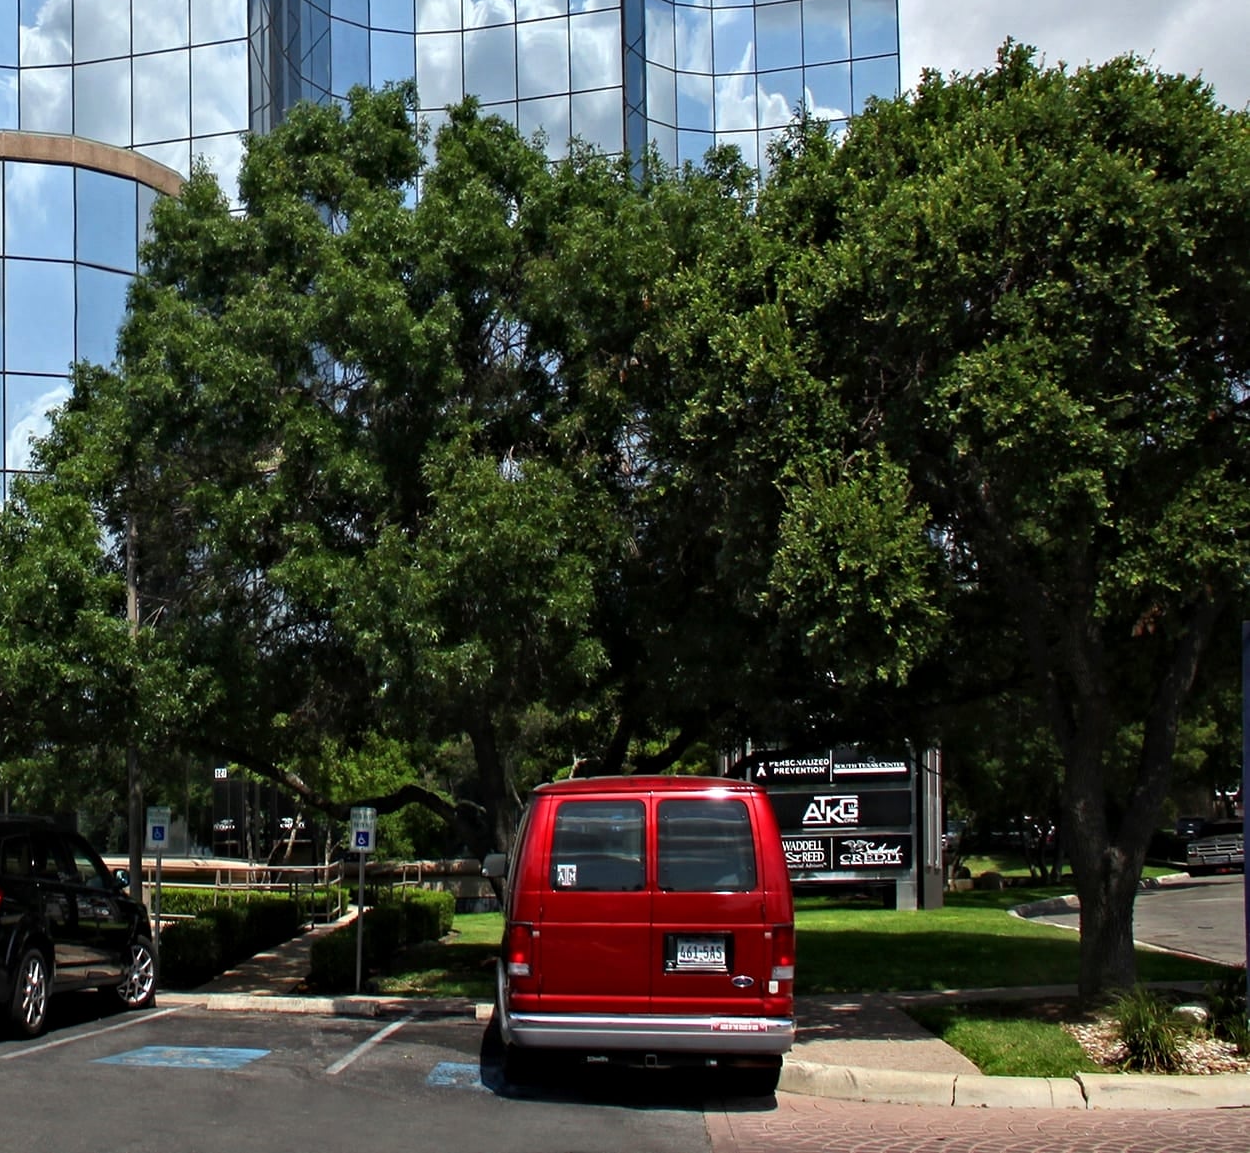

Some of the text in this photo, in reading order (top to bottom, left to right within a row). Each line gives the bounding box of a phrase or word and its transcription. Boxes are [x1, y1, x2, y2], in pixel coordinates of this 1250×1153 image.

[773, 767, 825, 775] PREVENTION
[802, 795, 858, 824] ATKG
[782, 840, 825, 851] WADDELL
[802, 851, 825, 862] REED
[839, 853, 903, 862] CREDIT
